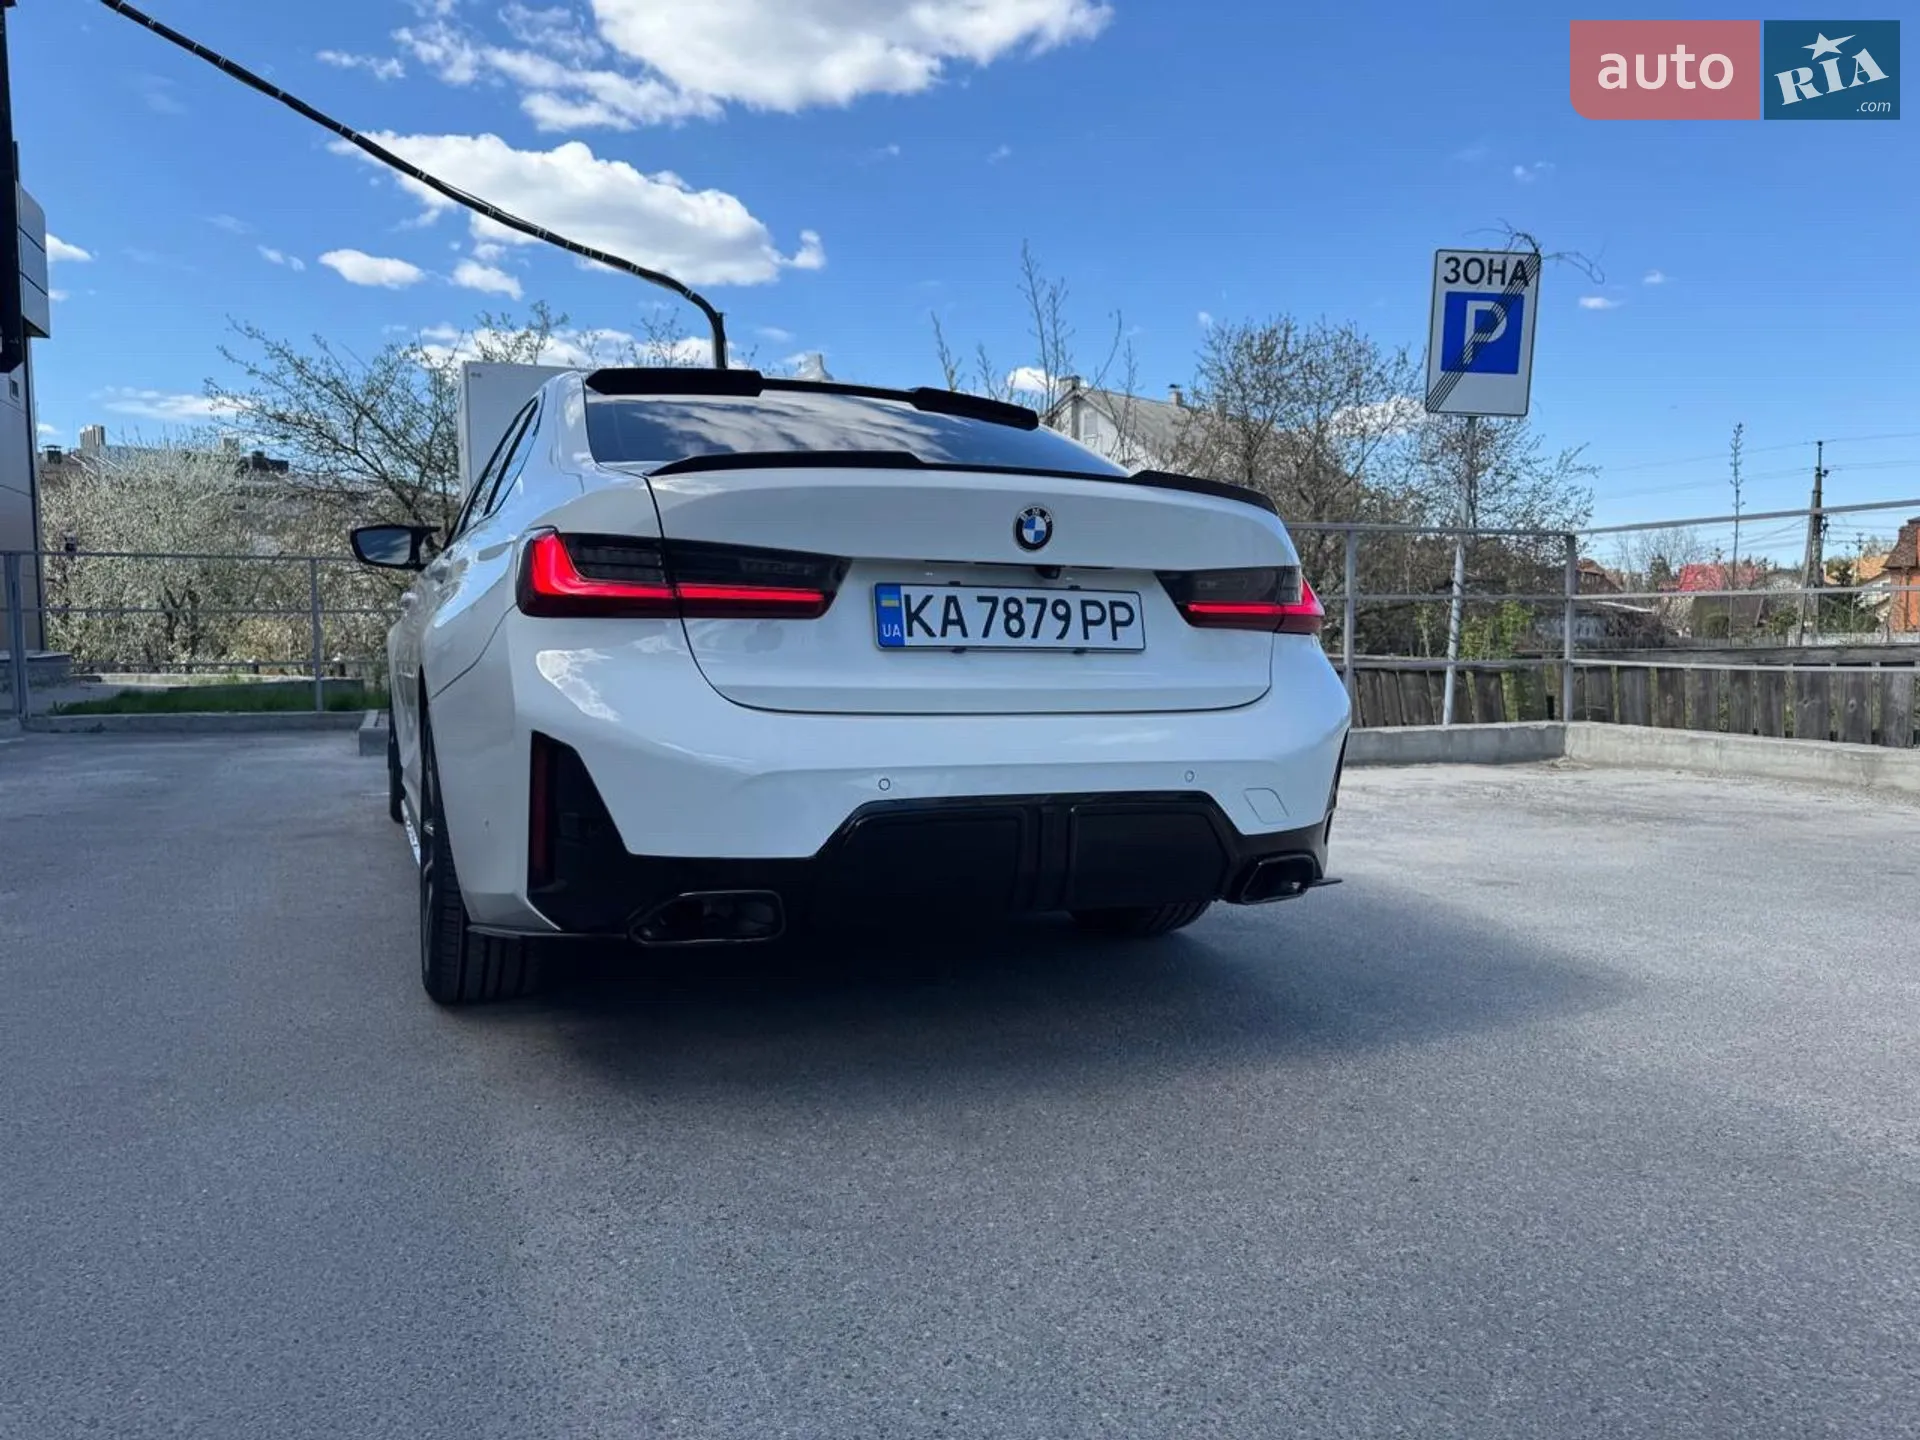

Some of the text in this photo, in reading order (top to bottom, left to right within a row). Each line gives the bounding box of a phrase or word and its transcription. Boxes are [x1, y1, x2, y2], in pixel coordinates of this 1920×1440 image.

[1443, 256, 1530, 287] ЗОНА
[1464, 300, 1508, 364] P
[882, 623, 902, 638] UA
[903, 593, 1135, 641] KA 7879 PP
